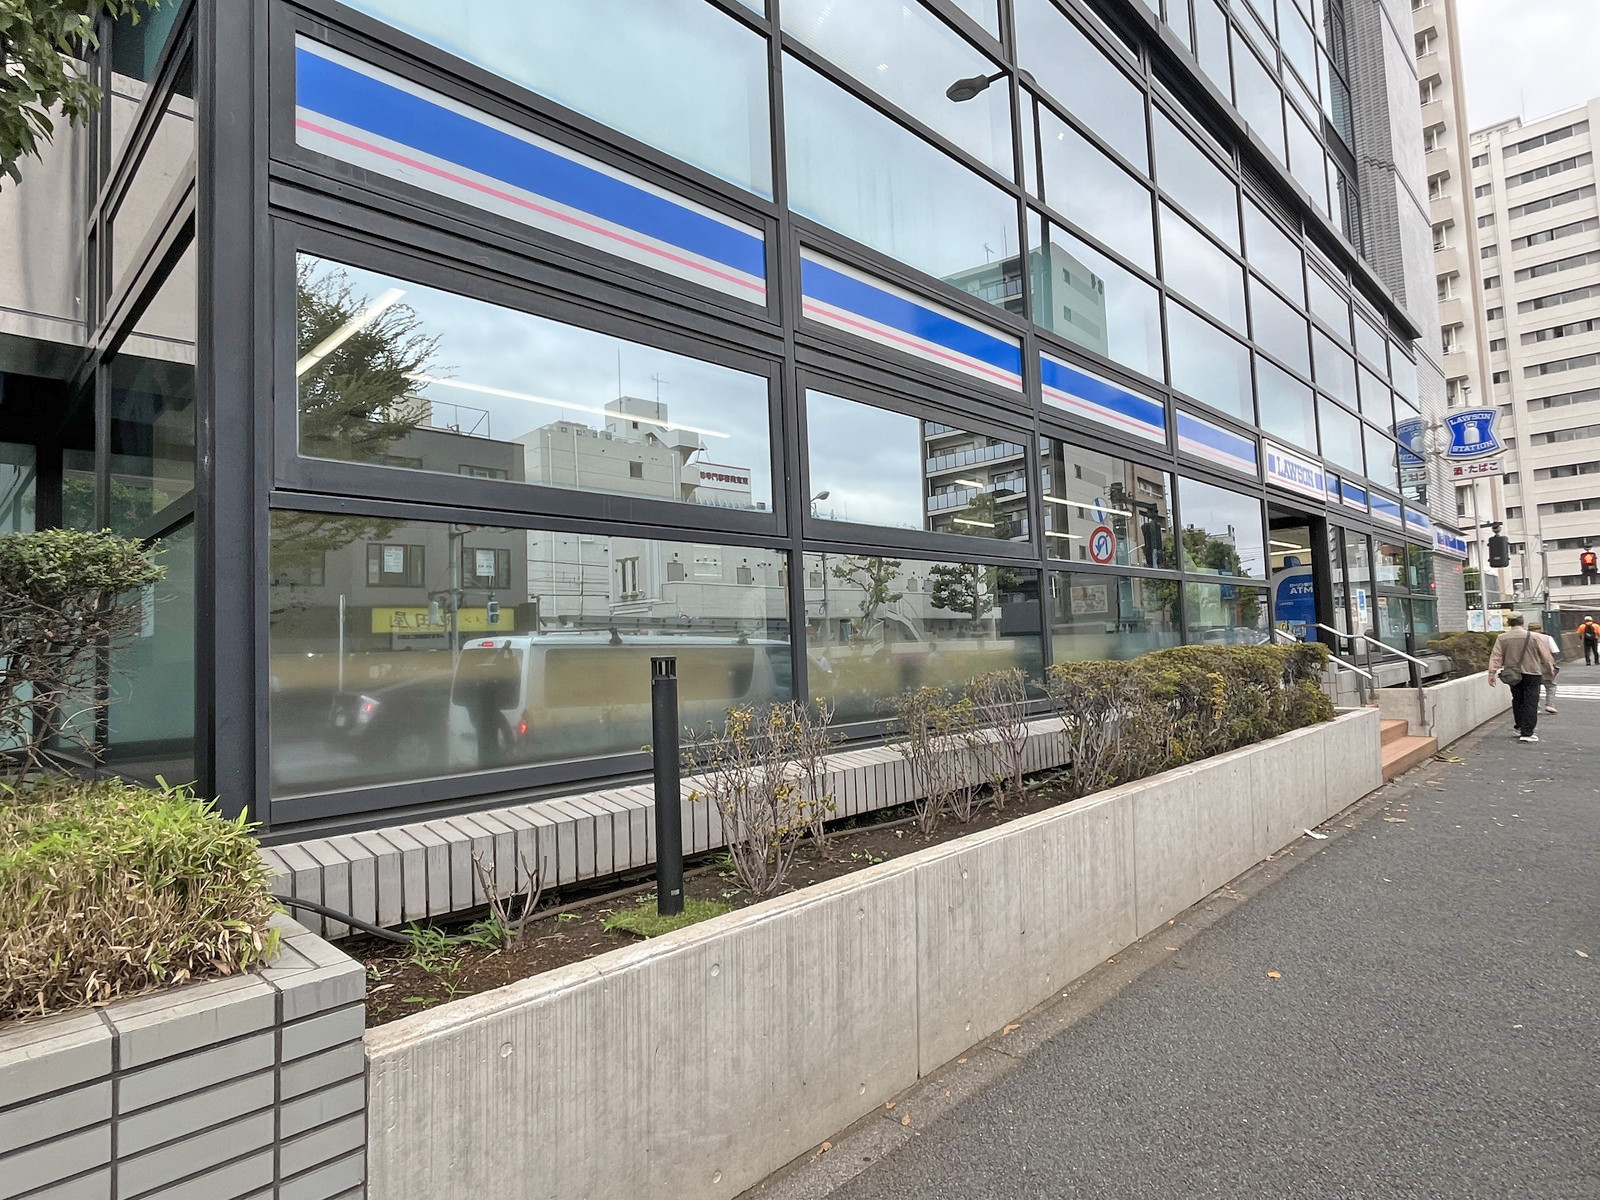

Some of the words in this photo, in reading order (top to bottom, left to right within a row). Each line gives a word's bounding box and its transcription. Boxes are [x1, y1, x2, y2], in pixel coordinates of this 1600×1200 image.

[1449, 413, 1491, 426] LAWSON
[1452, 440, 1494, 452] STATION
[1276, 455, 1315, 488] LAWSON
[1453, 462, 1498, 475] 酒・たばこ
[1289, 586, 1313, 594] ATM
